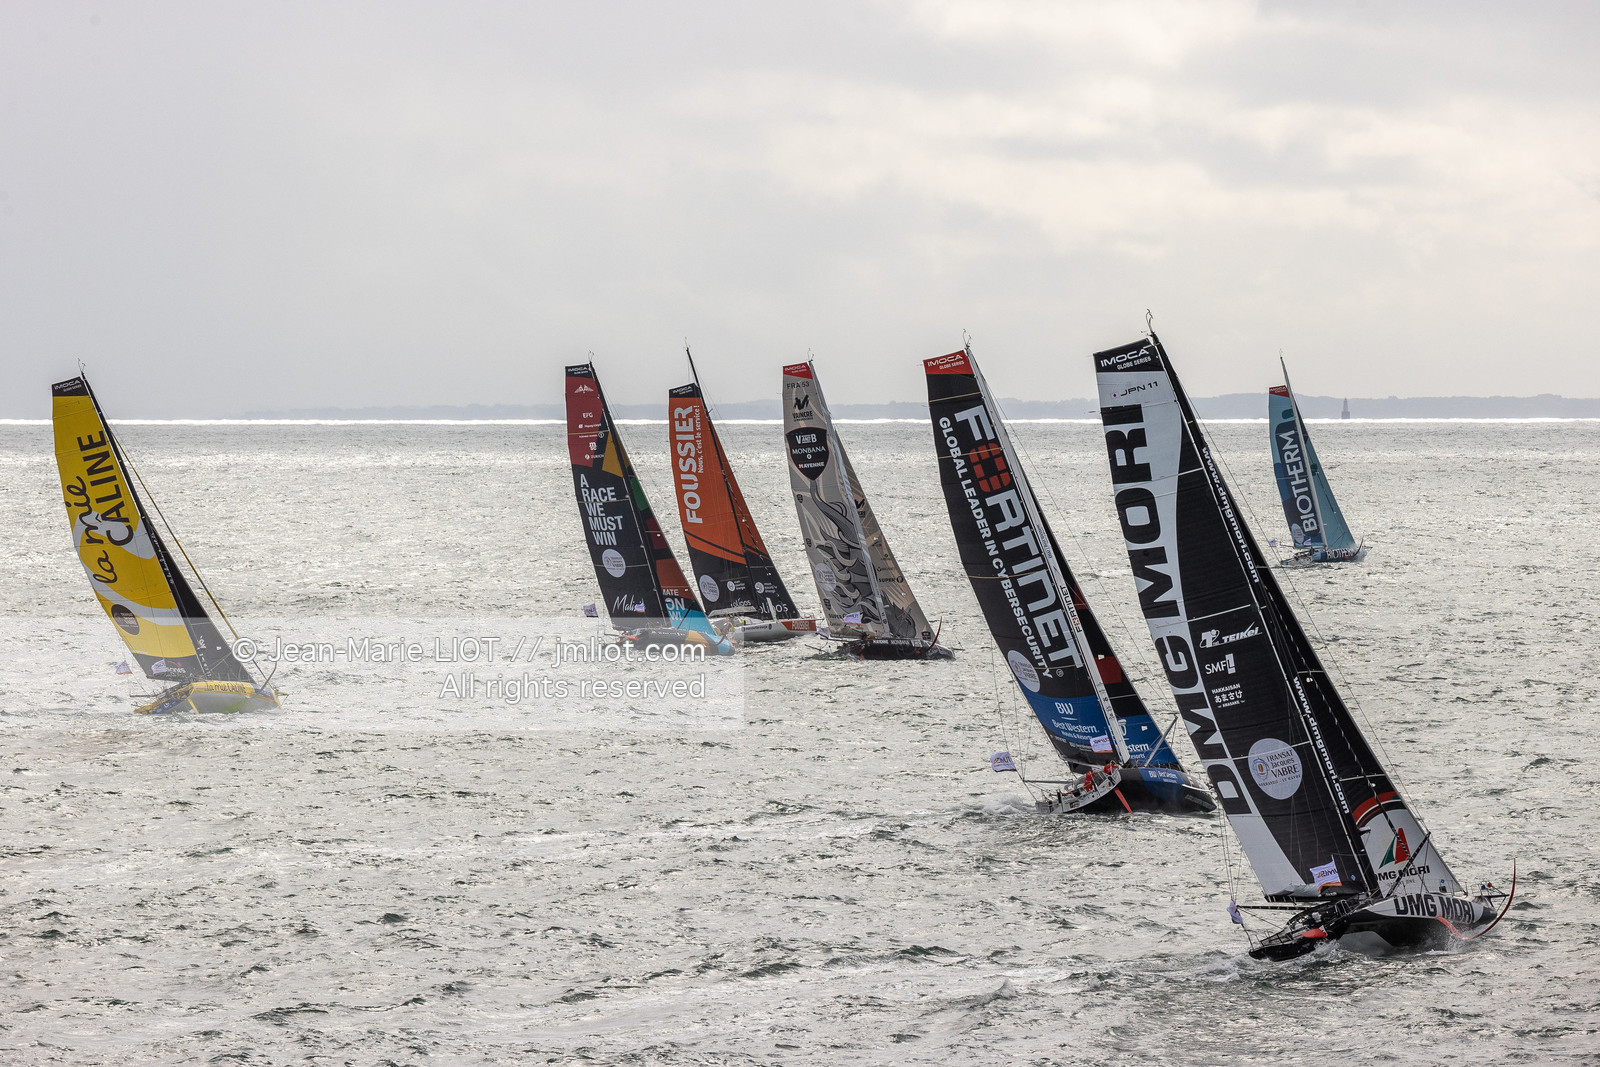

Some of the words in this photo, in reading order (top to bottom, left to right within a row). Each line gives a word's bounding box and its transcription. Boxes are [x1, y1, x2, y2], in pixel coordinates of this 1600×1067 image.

[928, 354, 962, 367] IMOCA
[1100, 348, 1149, 367] IMOCA
[1117, 360, 1133, 370] GLOBE
[1134, 356, 1151, 366] SERIES
[54, 380, 80, 390] IMOCA
[1120, 384, 1146, 397] JPN
[1148, 381, 1158, 389] 11
[792, 411, 813, 419] VAINCRE
[792, 446, 826, 455] MONBANA
[674, 406, 703, 523] FOUSSIER
[580, 474, 589, 488] A
[1279, 430, 1318, 533] BIOTHERM
[582, 487, 617, 502] RACE
[65, 476, 105, 545] mie
[585, 502, 606, 517] WE
[1100, 404, 1181, 619] MORI
[1202, 446, 1259, 583] www.dmgmori.com
[588, 516, 623, 531] MUST
[592, 531, 617, 546] WIN
[954, 404, 1083, 668] FORTINET
[938, 416, 968, 479] GLOBAL
[961, 479, 992, 541] LEADER
[985, 537, 999, 557] IN
[992, 554, 1053, 679] CYBERSECURITY
[93, 549, 118, 584] la
[1060, 585, 1082, 633] FORTINET
[1211, 683, 1241, 694] HAKKAISAN
[1214, 690, 1243, 703] あまさけ
[1055, 701, 1074, 715] BW
[1154, 635, 1252, 815] DMG
[1293, 676, 1350, 815] www.dmgmori.com
[1266, 749, 1293, 762] TRANSAT
[1270, 758, 1295, 769] Jacques
[1271, 764, 1299, 778] VABRE
[1397, 865, 1430, 877] MORI
[1394, 893, 1437, 917] DMG
[1440, 896, 1475, 925] MORI
